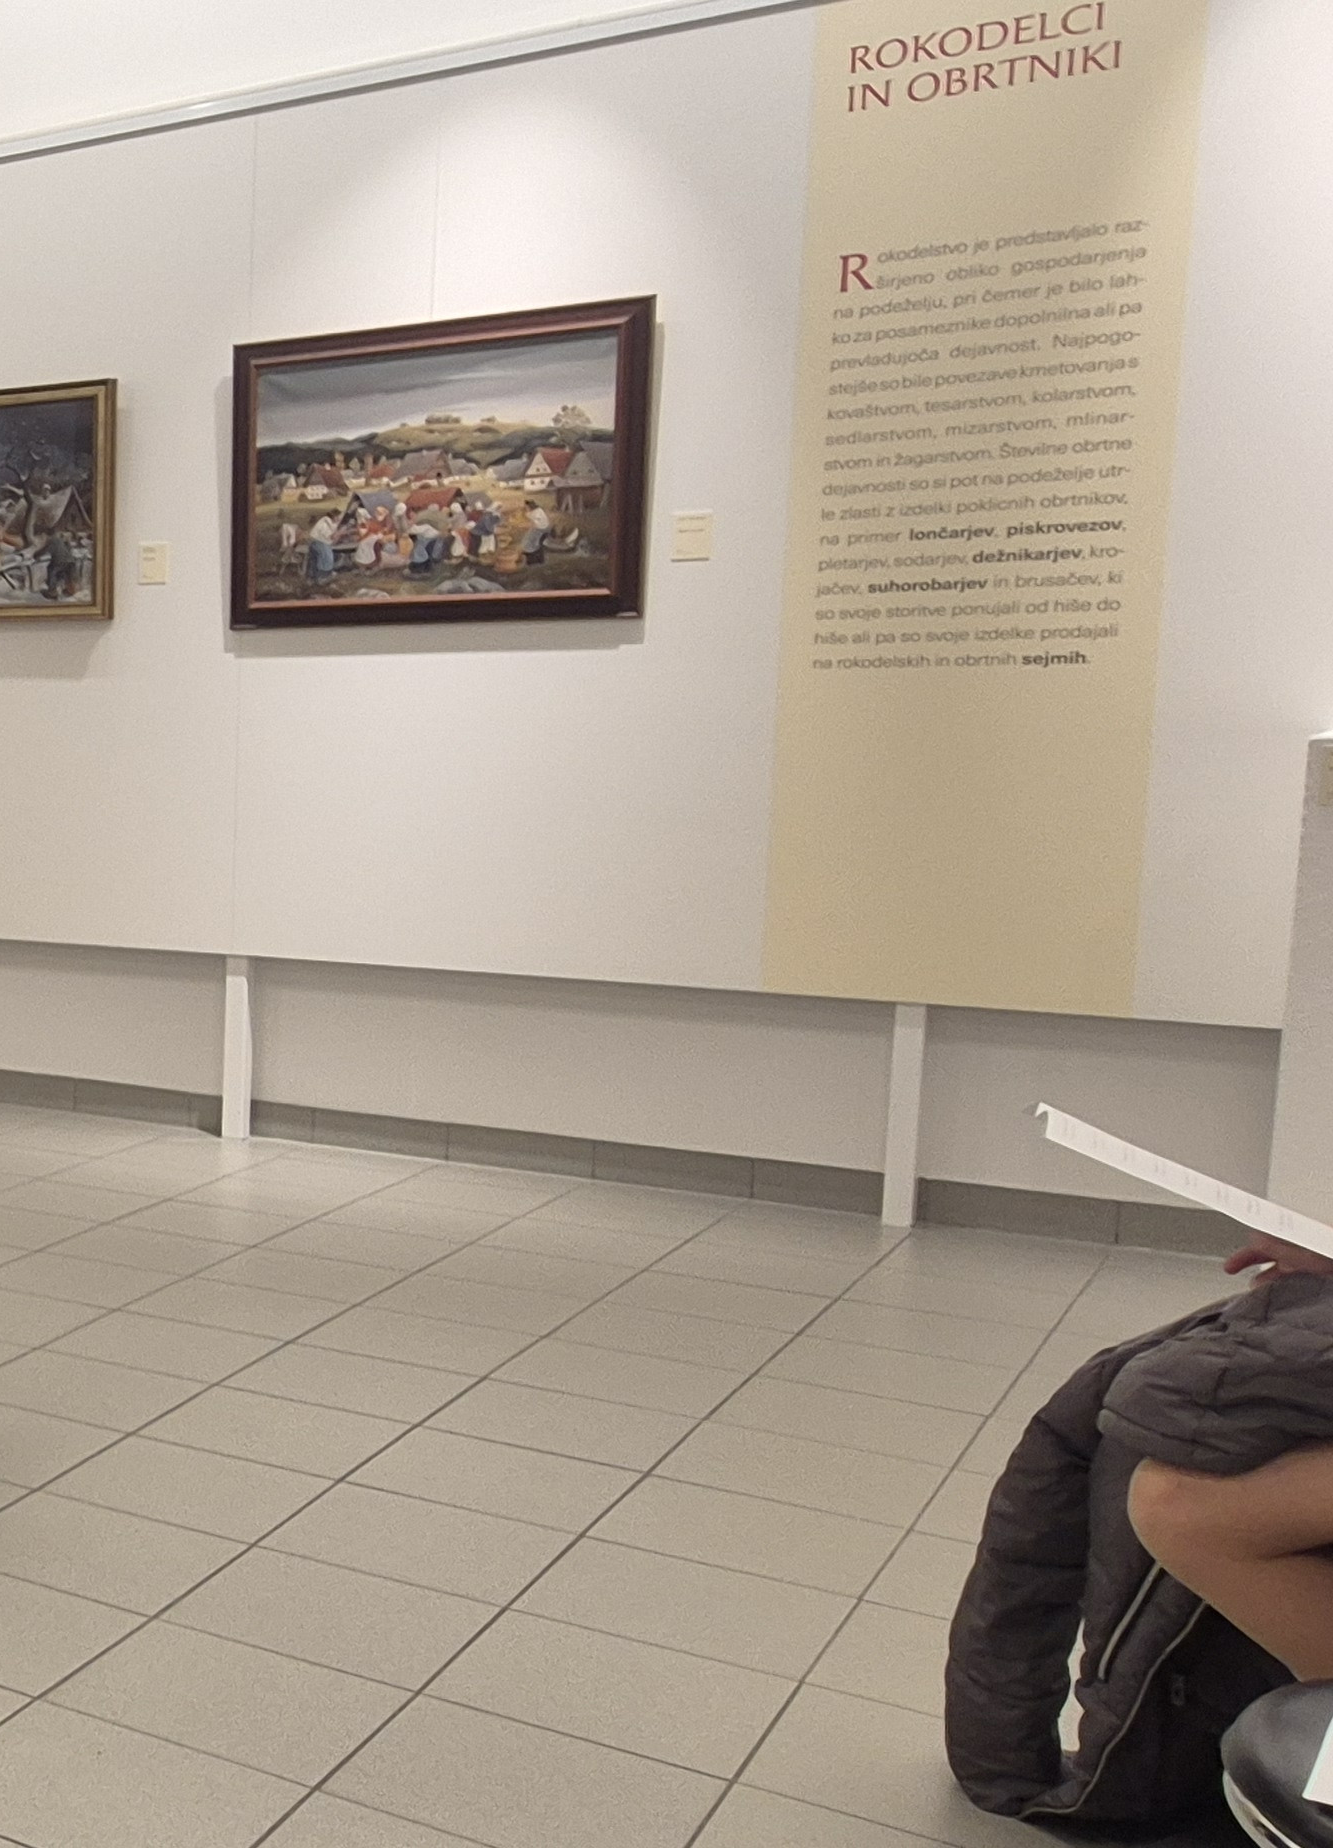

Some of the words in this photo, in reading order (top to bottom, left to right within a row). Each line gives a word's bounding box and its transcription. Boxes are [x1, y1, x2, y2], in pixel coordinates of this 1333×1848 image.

[849, 1, 1106, 74] ROKODELCI
[847, 79, 892, 112] IN
[906, 40, 1122, 102] OBRTNIKI
